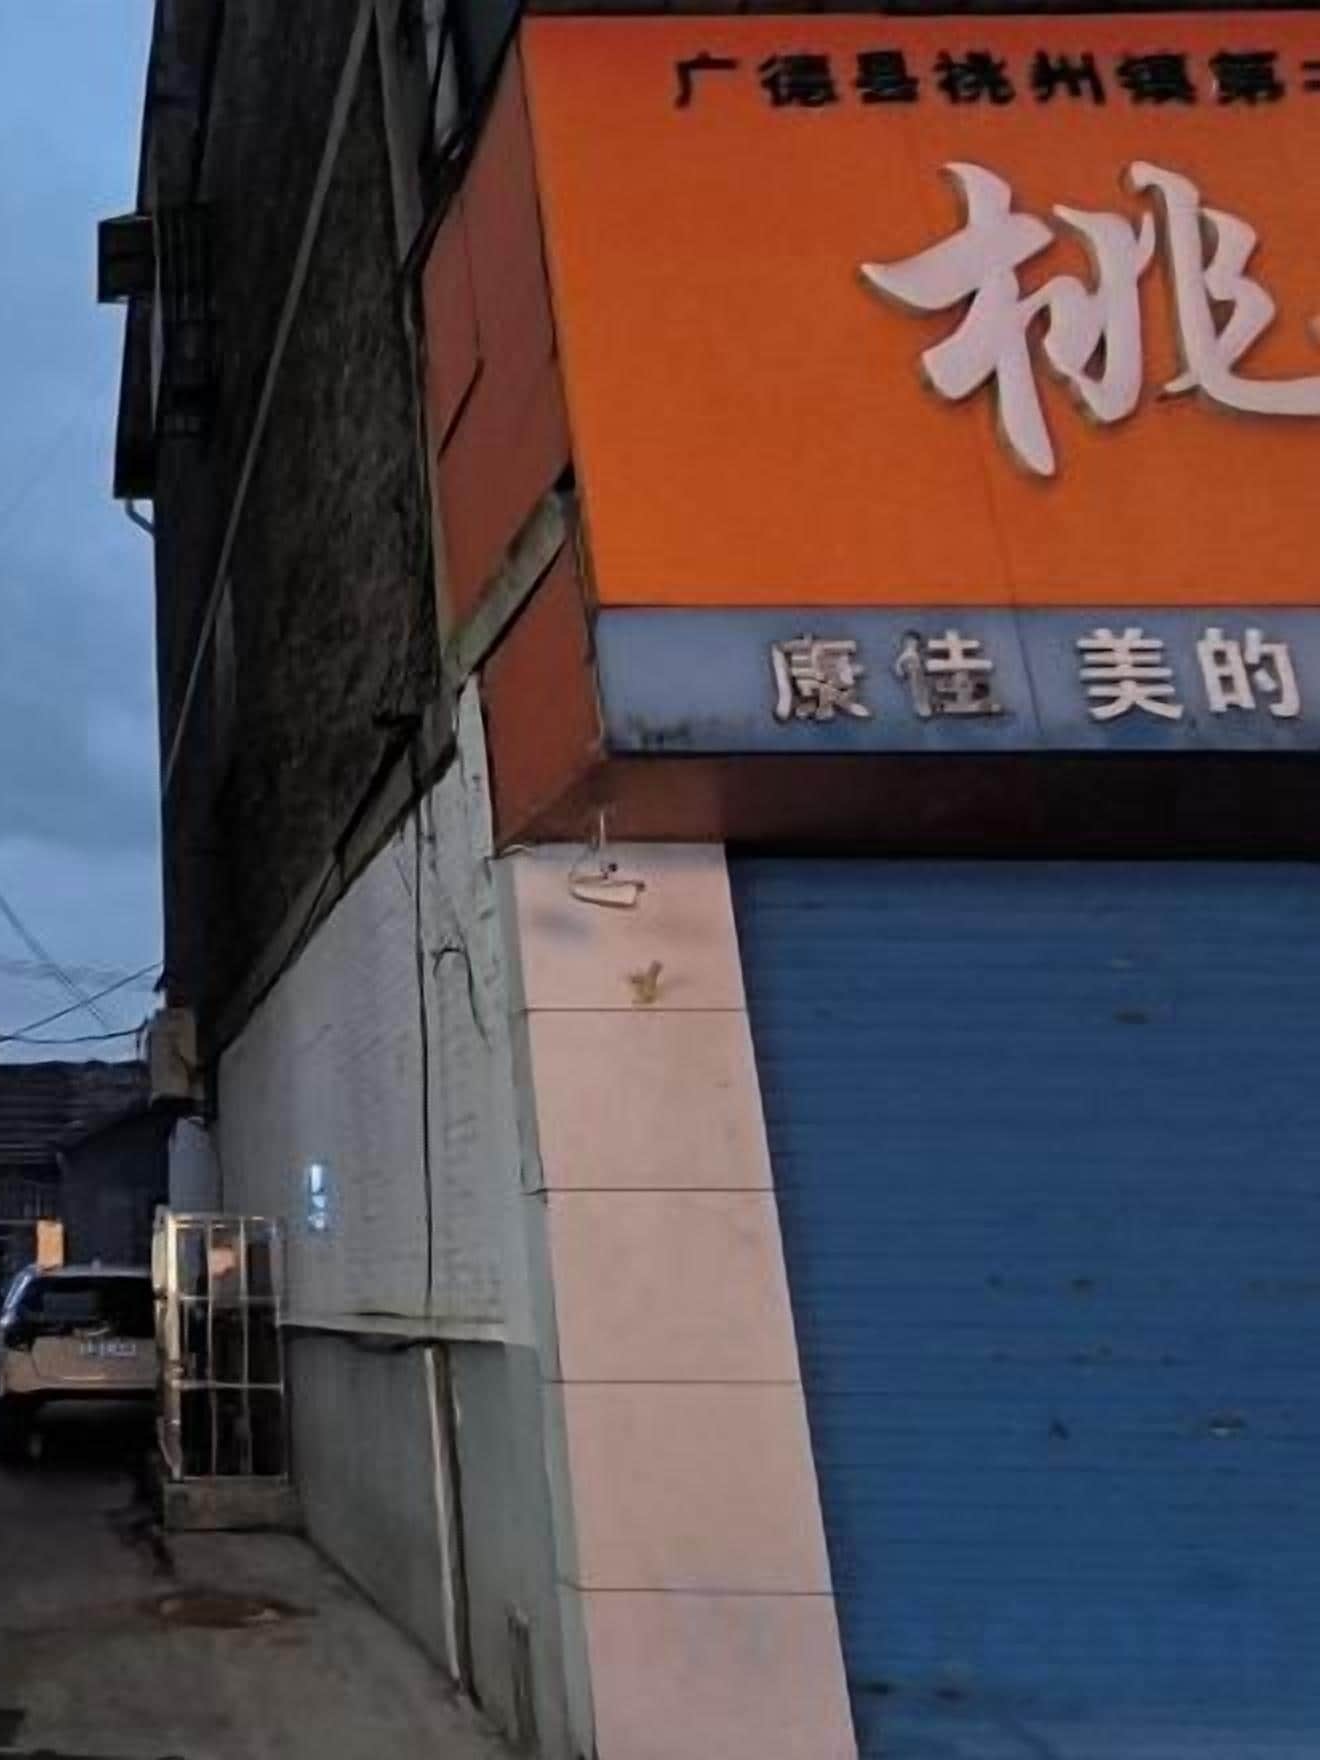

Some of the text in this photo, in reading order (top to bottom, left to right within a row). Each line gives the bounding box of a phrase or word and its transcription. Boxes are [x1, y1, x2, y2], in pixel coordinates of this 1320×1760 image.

[674, 50, 1320, 109] 广德县桃州镇第
[1076, 626, 1302, 721] 美的
